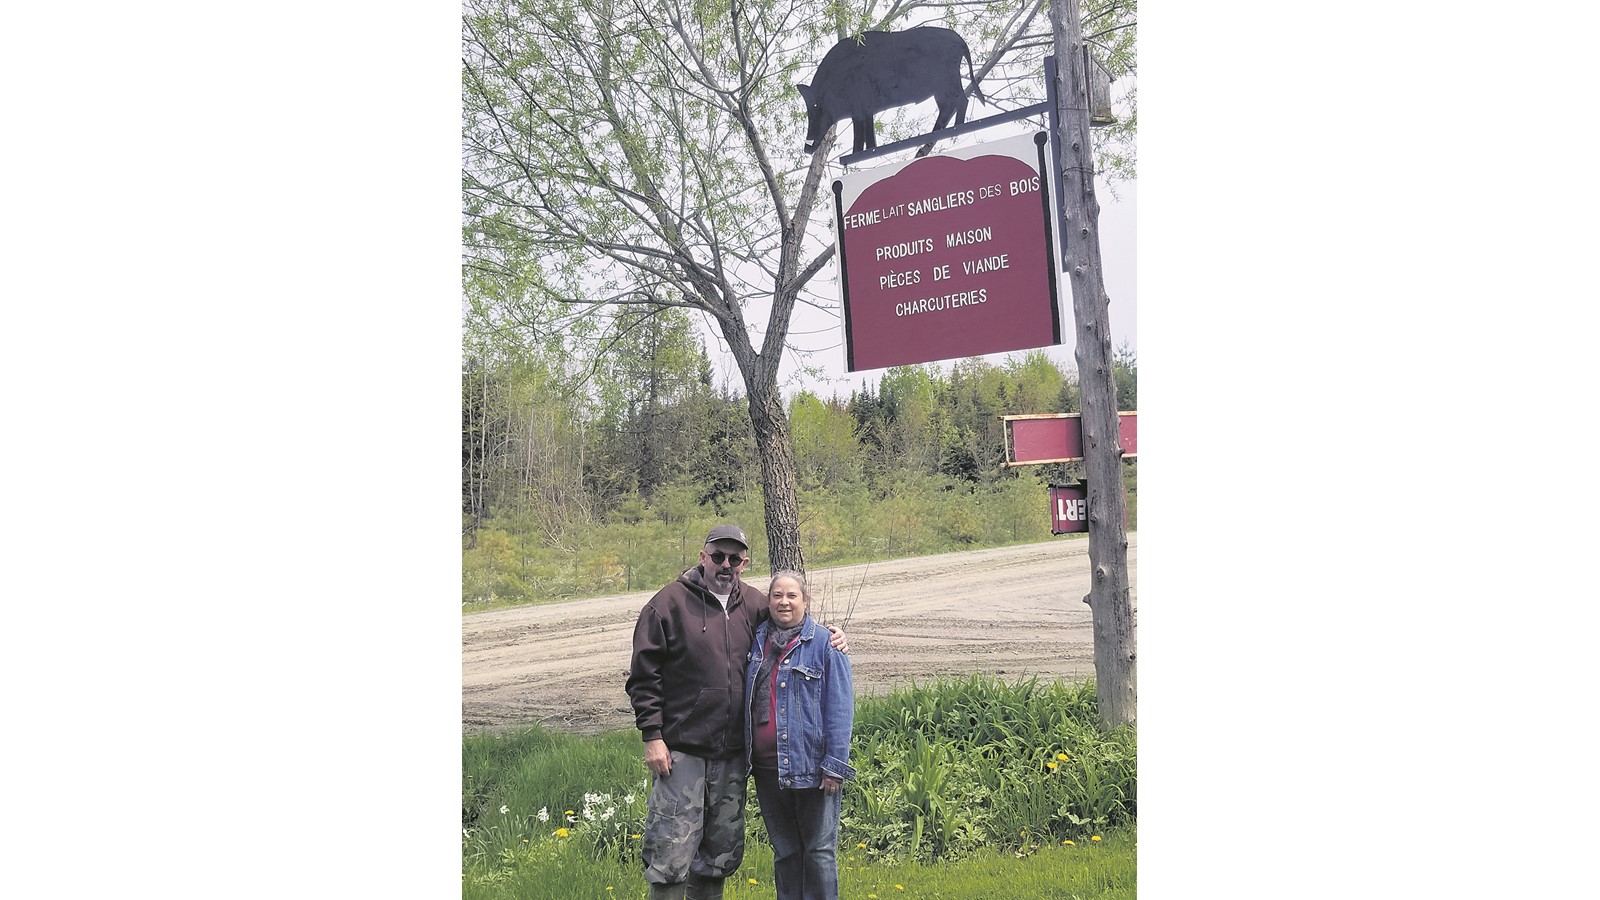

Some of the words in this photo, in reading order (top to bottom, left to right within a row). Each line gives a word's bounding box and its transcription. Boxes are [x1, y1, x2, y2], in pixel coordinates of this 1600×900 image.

[844, 210, 881, 229] FERME
[882, 204, 905, 219] LAIT
[908, 190, 974, 217] SANGLIERS
[979, 184, 1002, 199] DES
[1010, 176, 1040, 196] BOIS
[876, 238, 934, 261] PRODUITS
[946, 227, 992, 248] MAISON
[879, 269, 921, 290] PIÈCES
[933, 265, 950, 281] DE
[963, 254, 1009, 275] VIANDE
[895, 289, 987, 317] CHARCUTERIES
